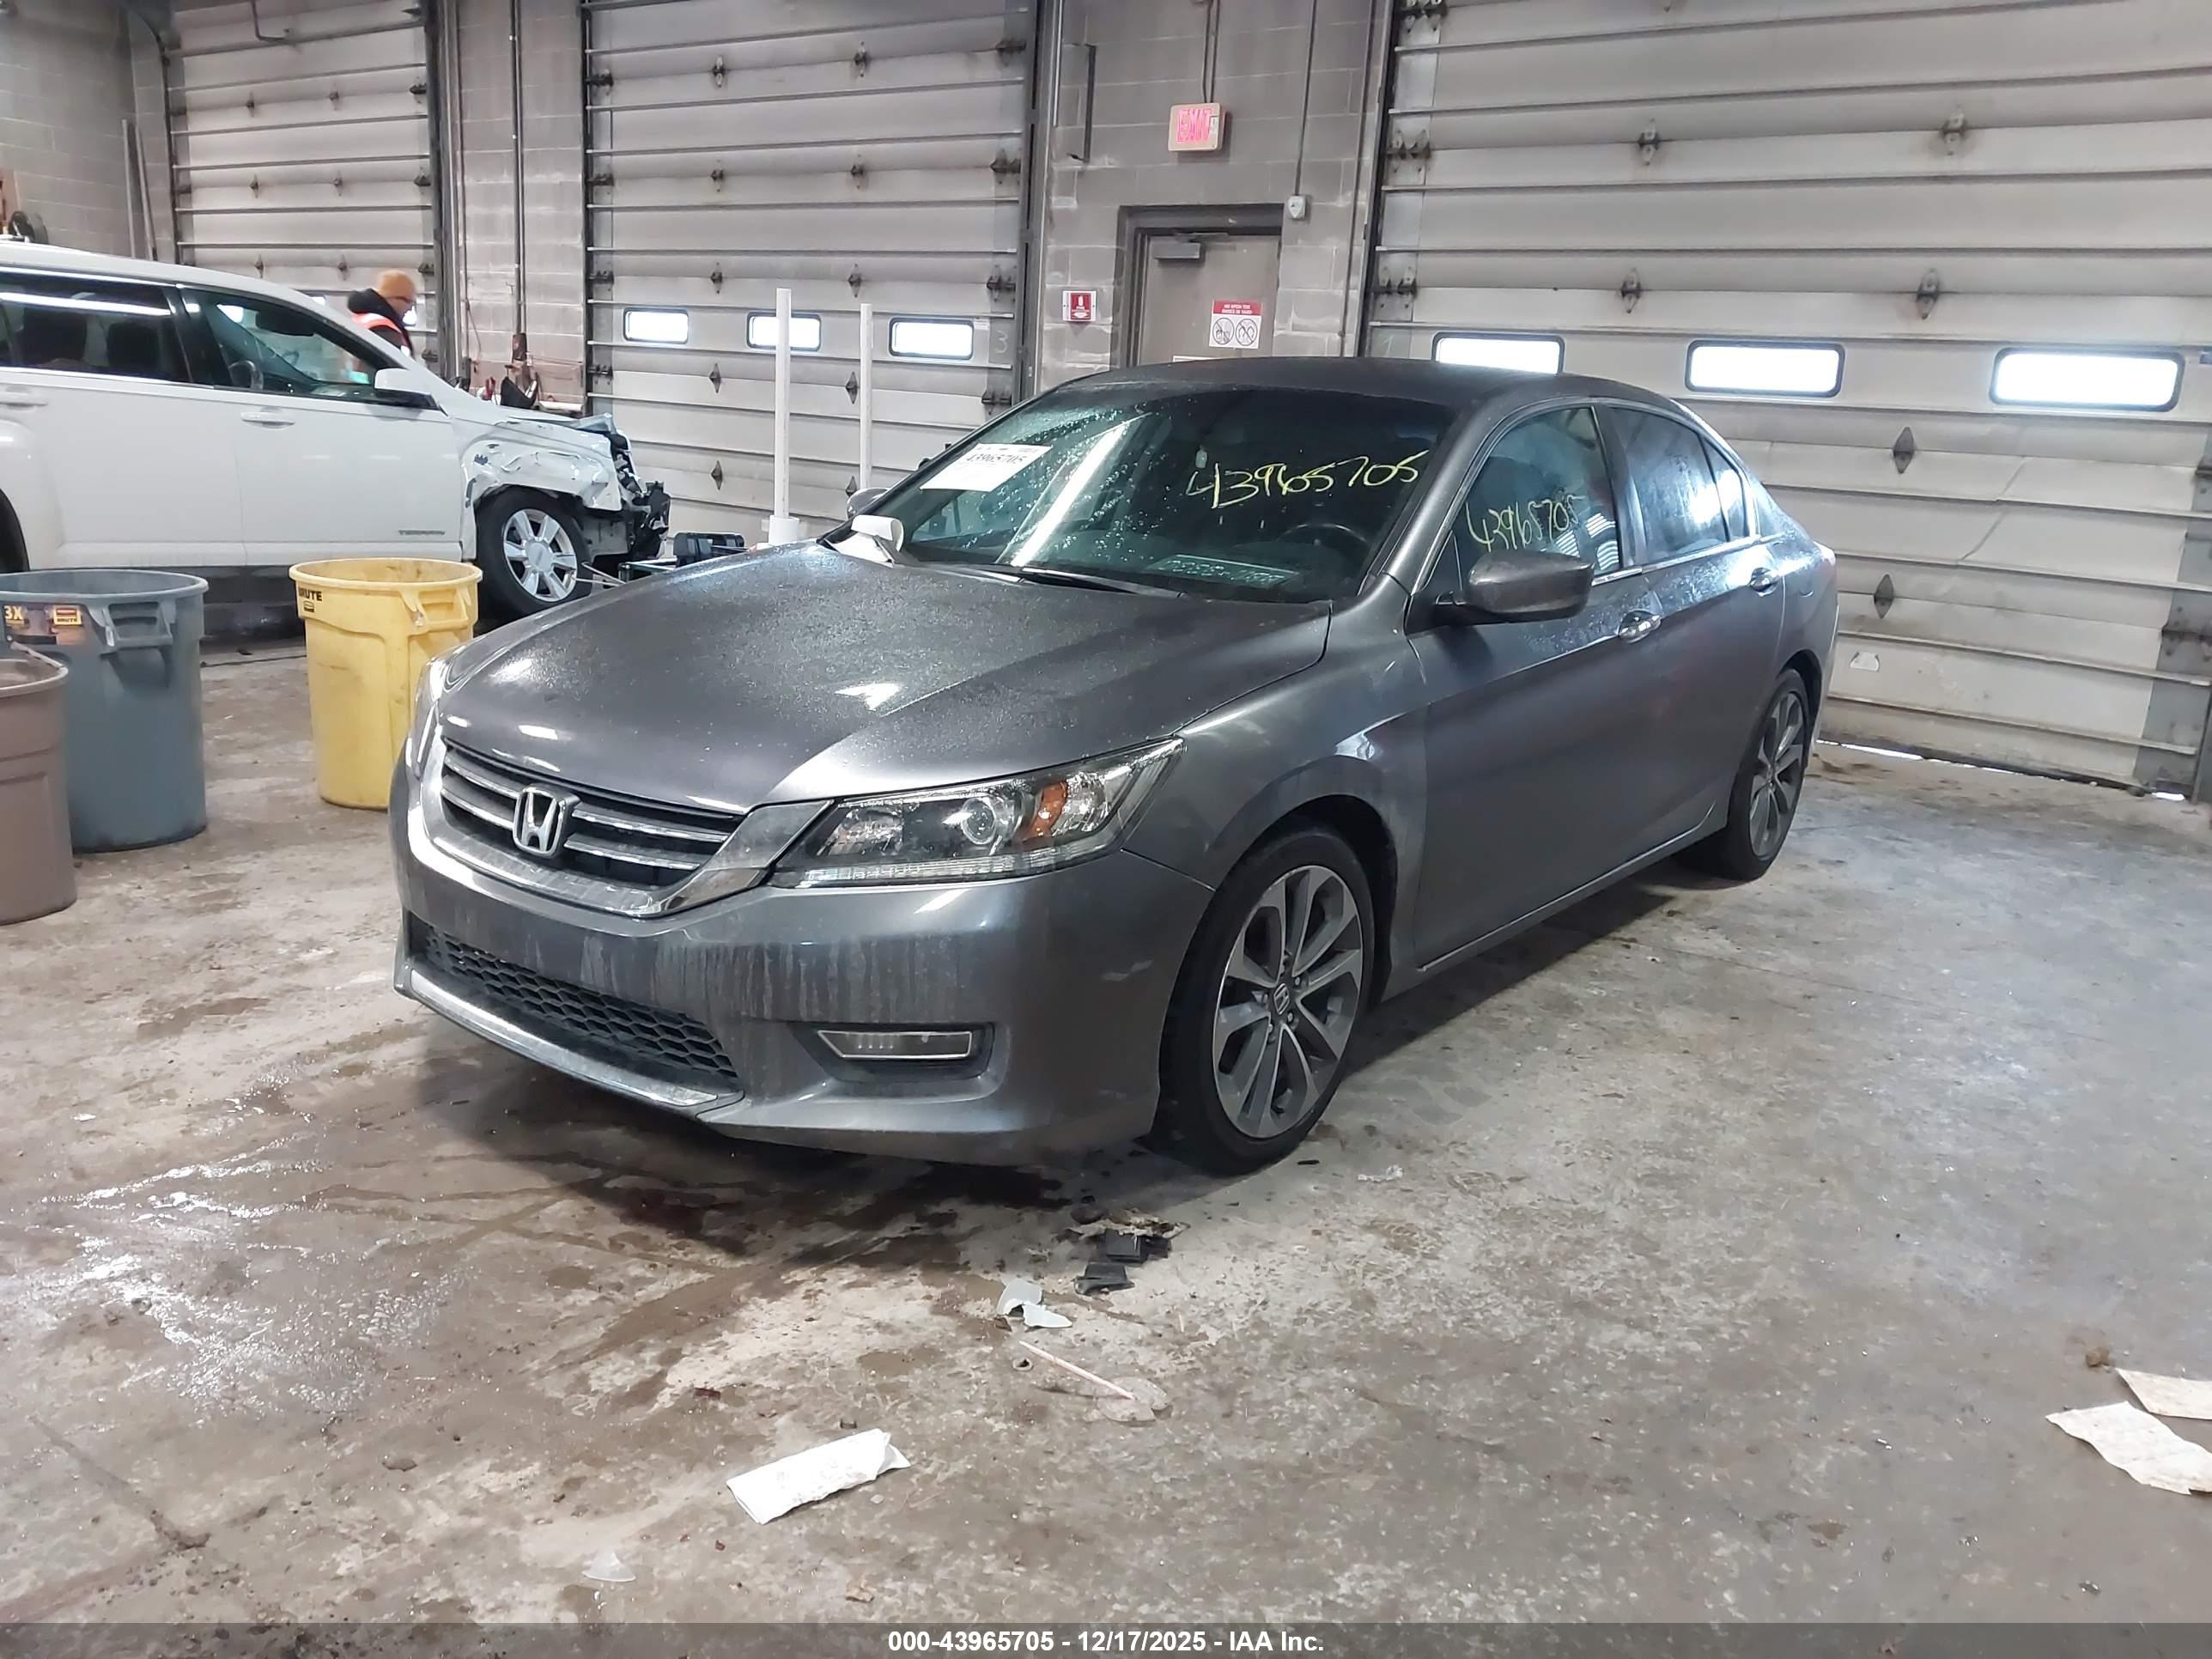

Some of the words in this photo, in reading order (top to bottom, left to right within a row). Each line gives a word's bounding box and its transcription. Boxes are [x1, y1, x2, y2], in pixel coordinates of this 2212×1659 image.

[1176, 109, 1213, 143] EXIT
[1185, 449, 1430, 509] 43965705
[1465, 495, 1586, 552] 43965705
